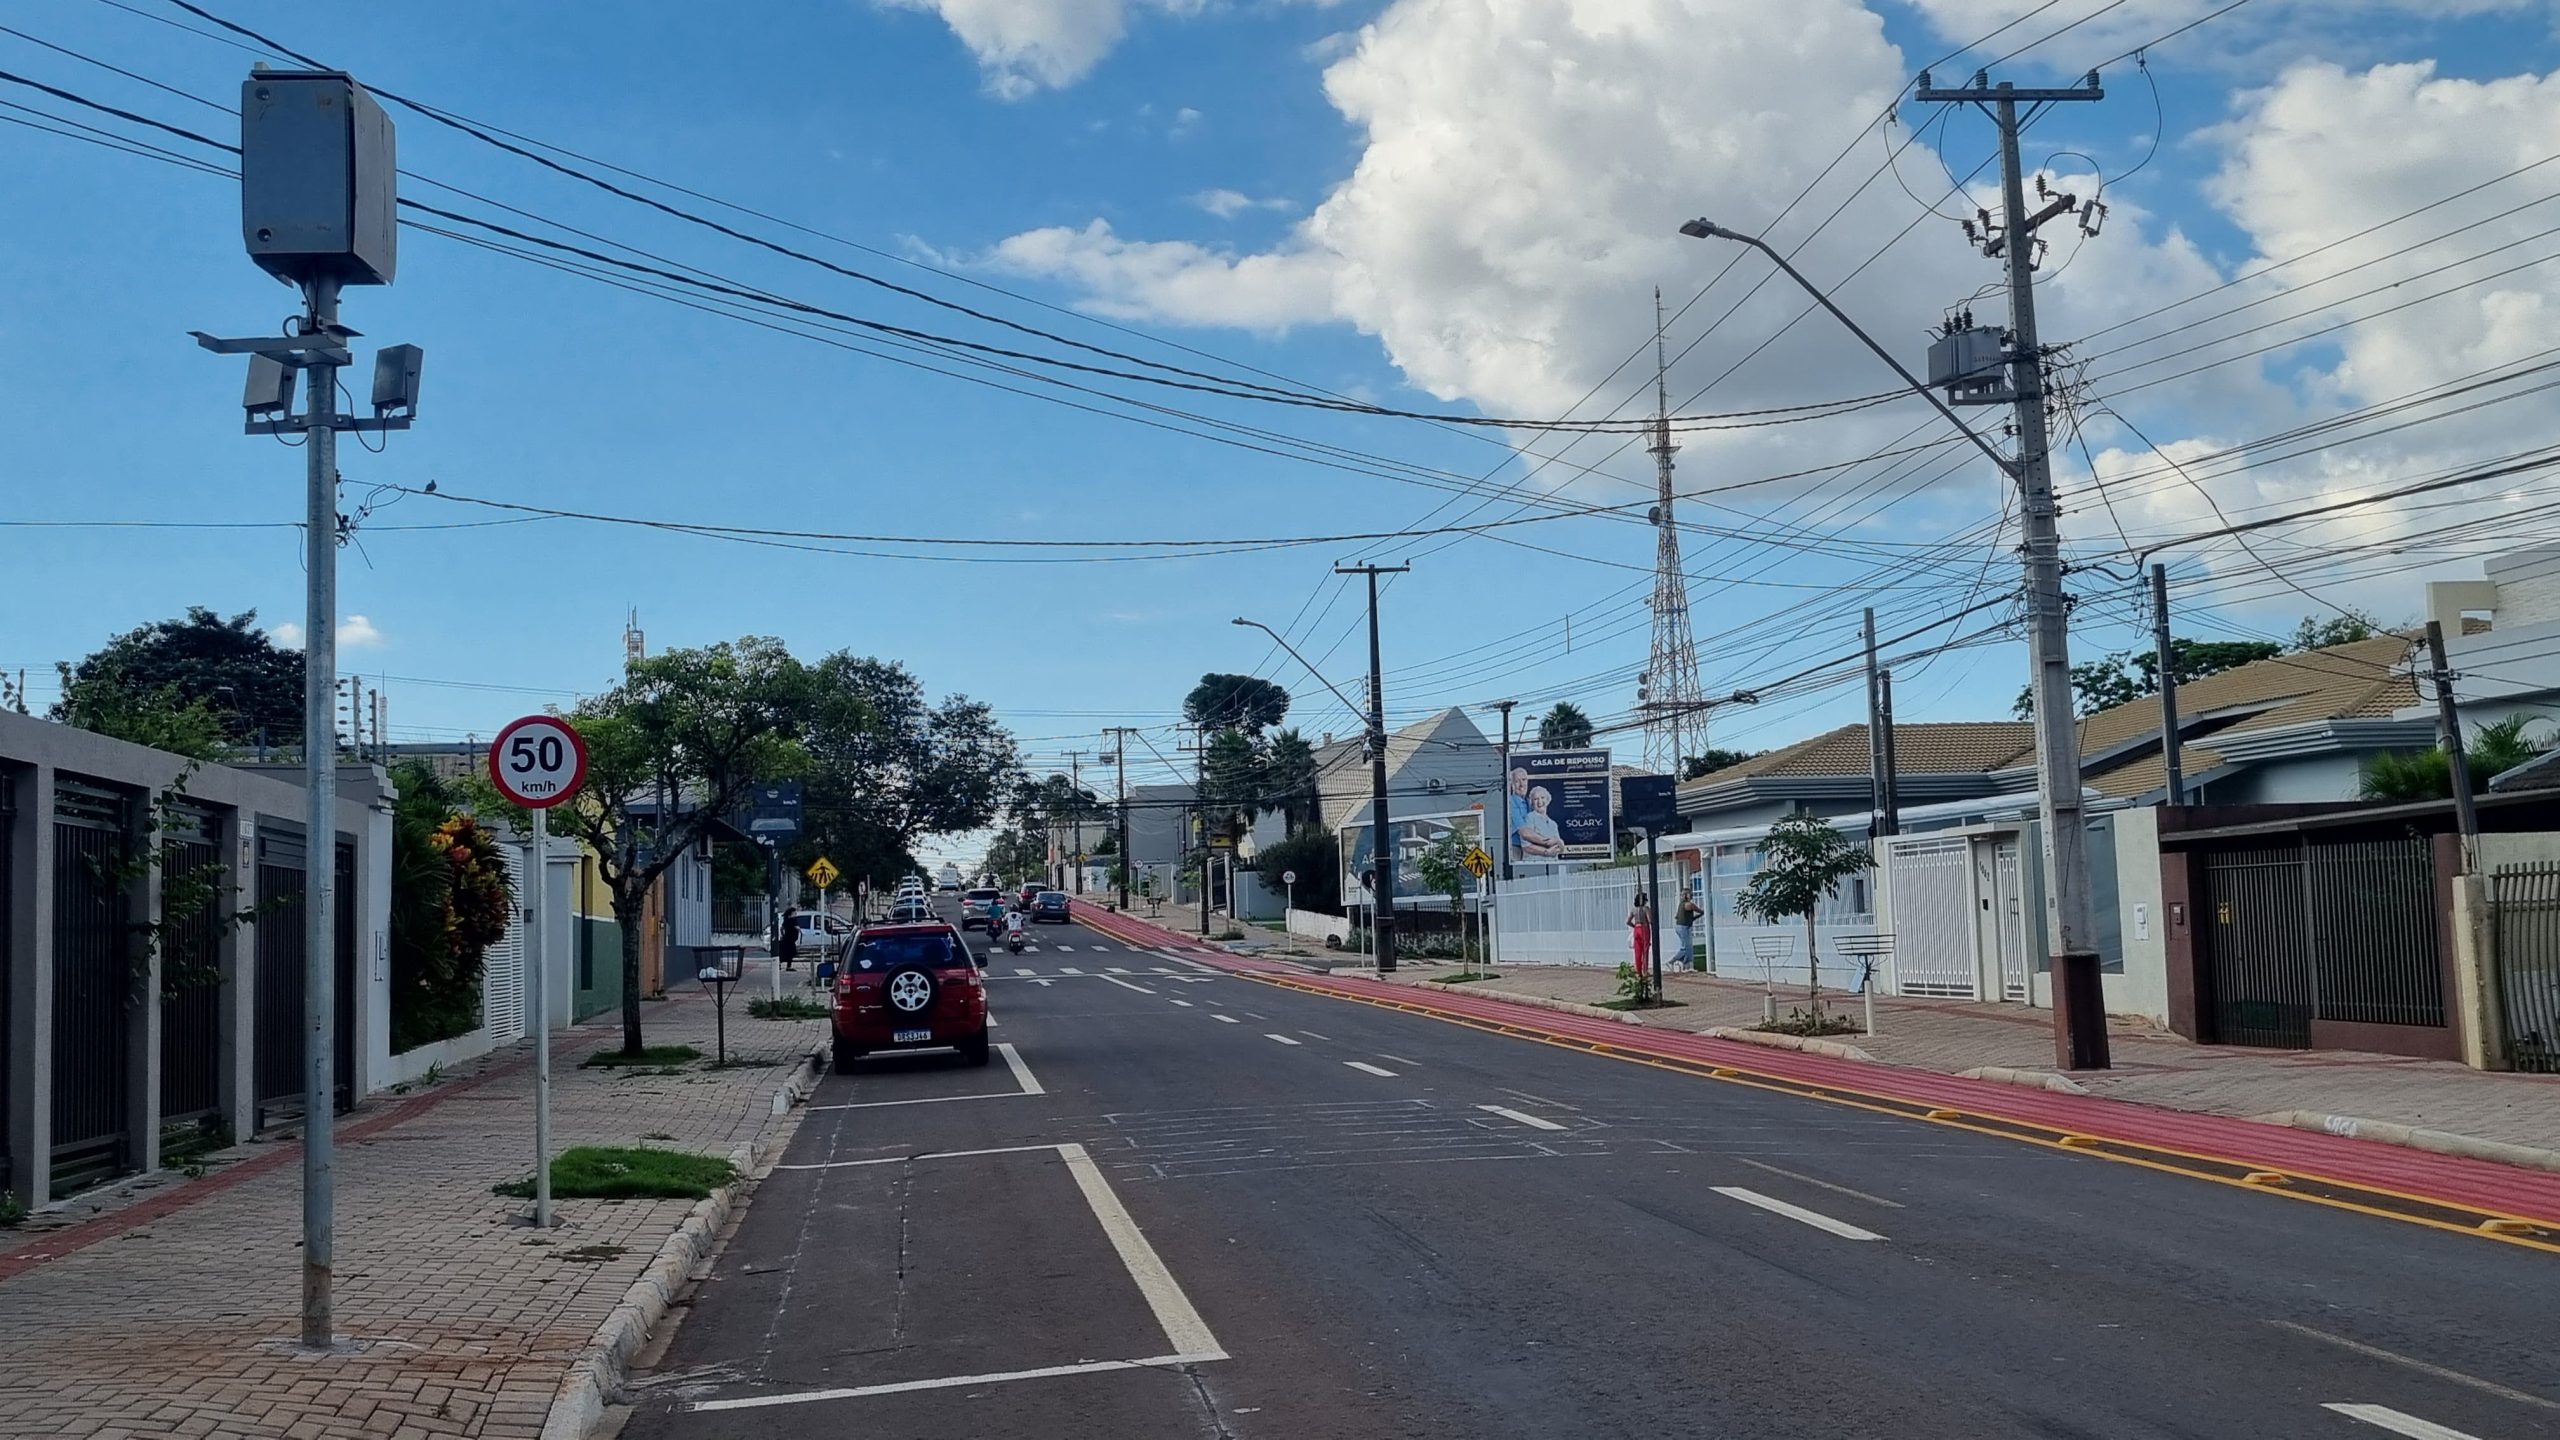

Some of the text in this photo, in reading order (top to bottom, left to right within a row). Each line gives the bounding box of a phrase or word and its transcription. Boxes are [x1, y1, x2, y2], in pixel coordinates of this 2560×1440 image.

[511, 736, 563, 773] 50
[1531, 756, 1605, 767] CASA DE REPOUSO
[521, 780, 556, 793] km/h
[1565, 818, 1602, 828] SOLARY
